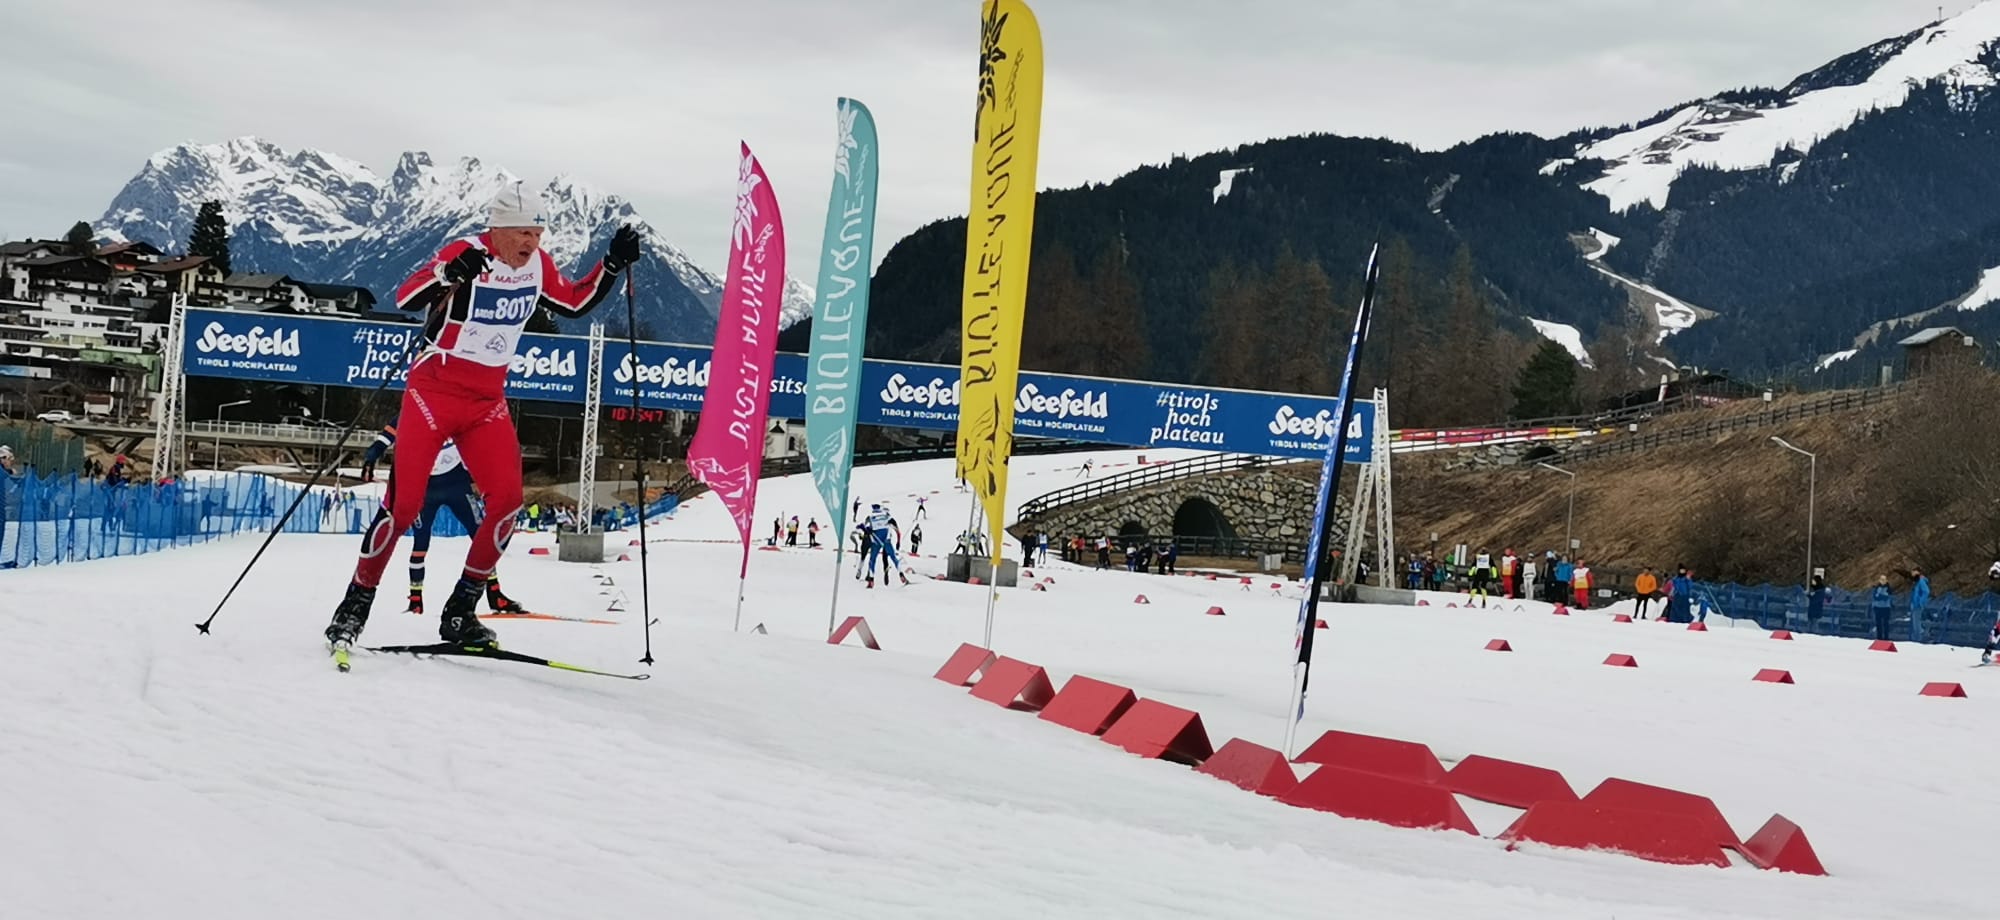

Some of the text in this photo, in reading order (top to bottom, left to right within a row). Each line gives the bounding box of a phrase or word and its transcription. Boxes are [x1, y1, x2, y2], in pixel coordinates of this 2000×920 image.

[495, 295, 535, 320] 8017
[195, 321, 301, 361] Seefeld
[197, 357, 298, 372] TIROLS HOCHPLATEAU
[508, 346, 576, 378] efeld
[612, 352, 713, 391] Seefeld
[510, 380, 574, 393] HOCHPLATEAU
[615, 388, 704, 402] TIROS HOCHPLATEA
[880, 373, 961, 411] Seefel
[1014, 382, 1109, 419] Seefeld
[1156, 391, 1219, 411] #tirols
[881, 408, 959, 421] TIROLS HOCHPLAT
[1165, 407, 1211, 427] hoch
[1268, 404, 1363, 440] Seefed
[1044, 421, 1105, 433] HOCHPLATEAU
[1150, 424, 1224, 445] plateau
